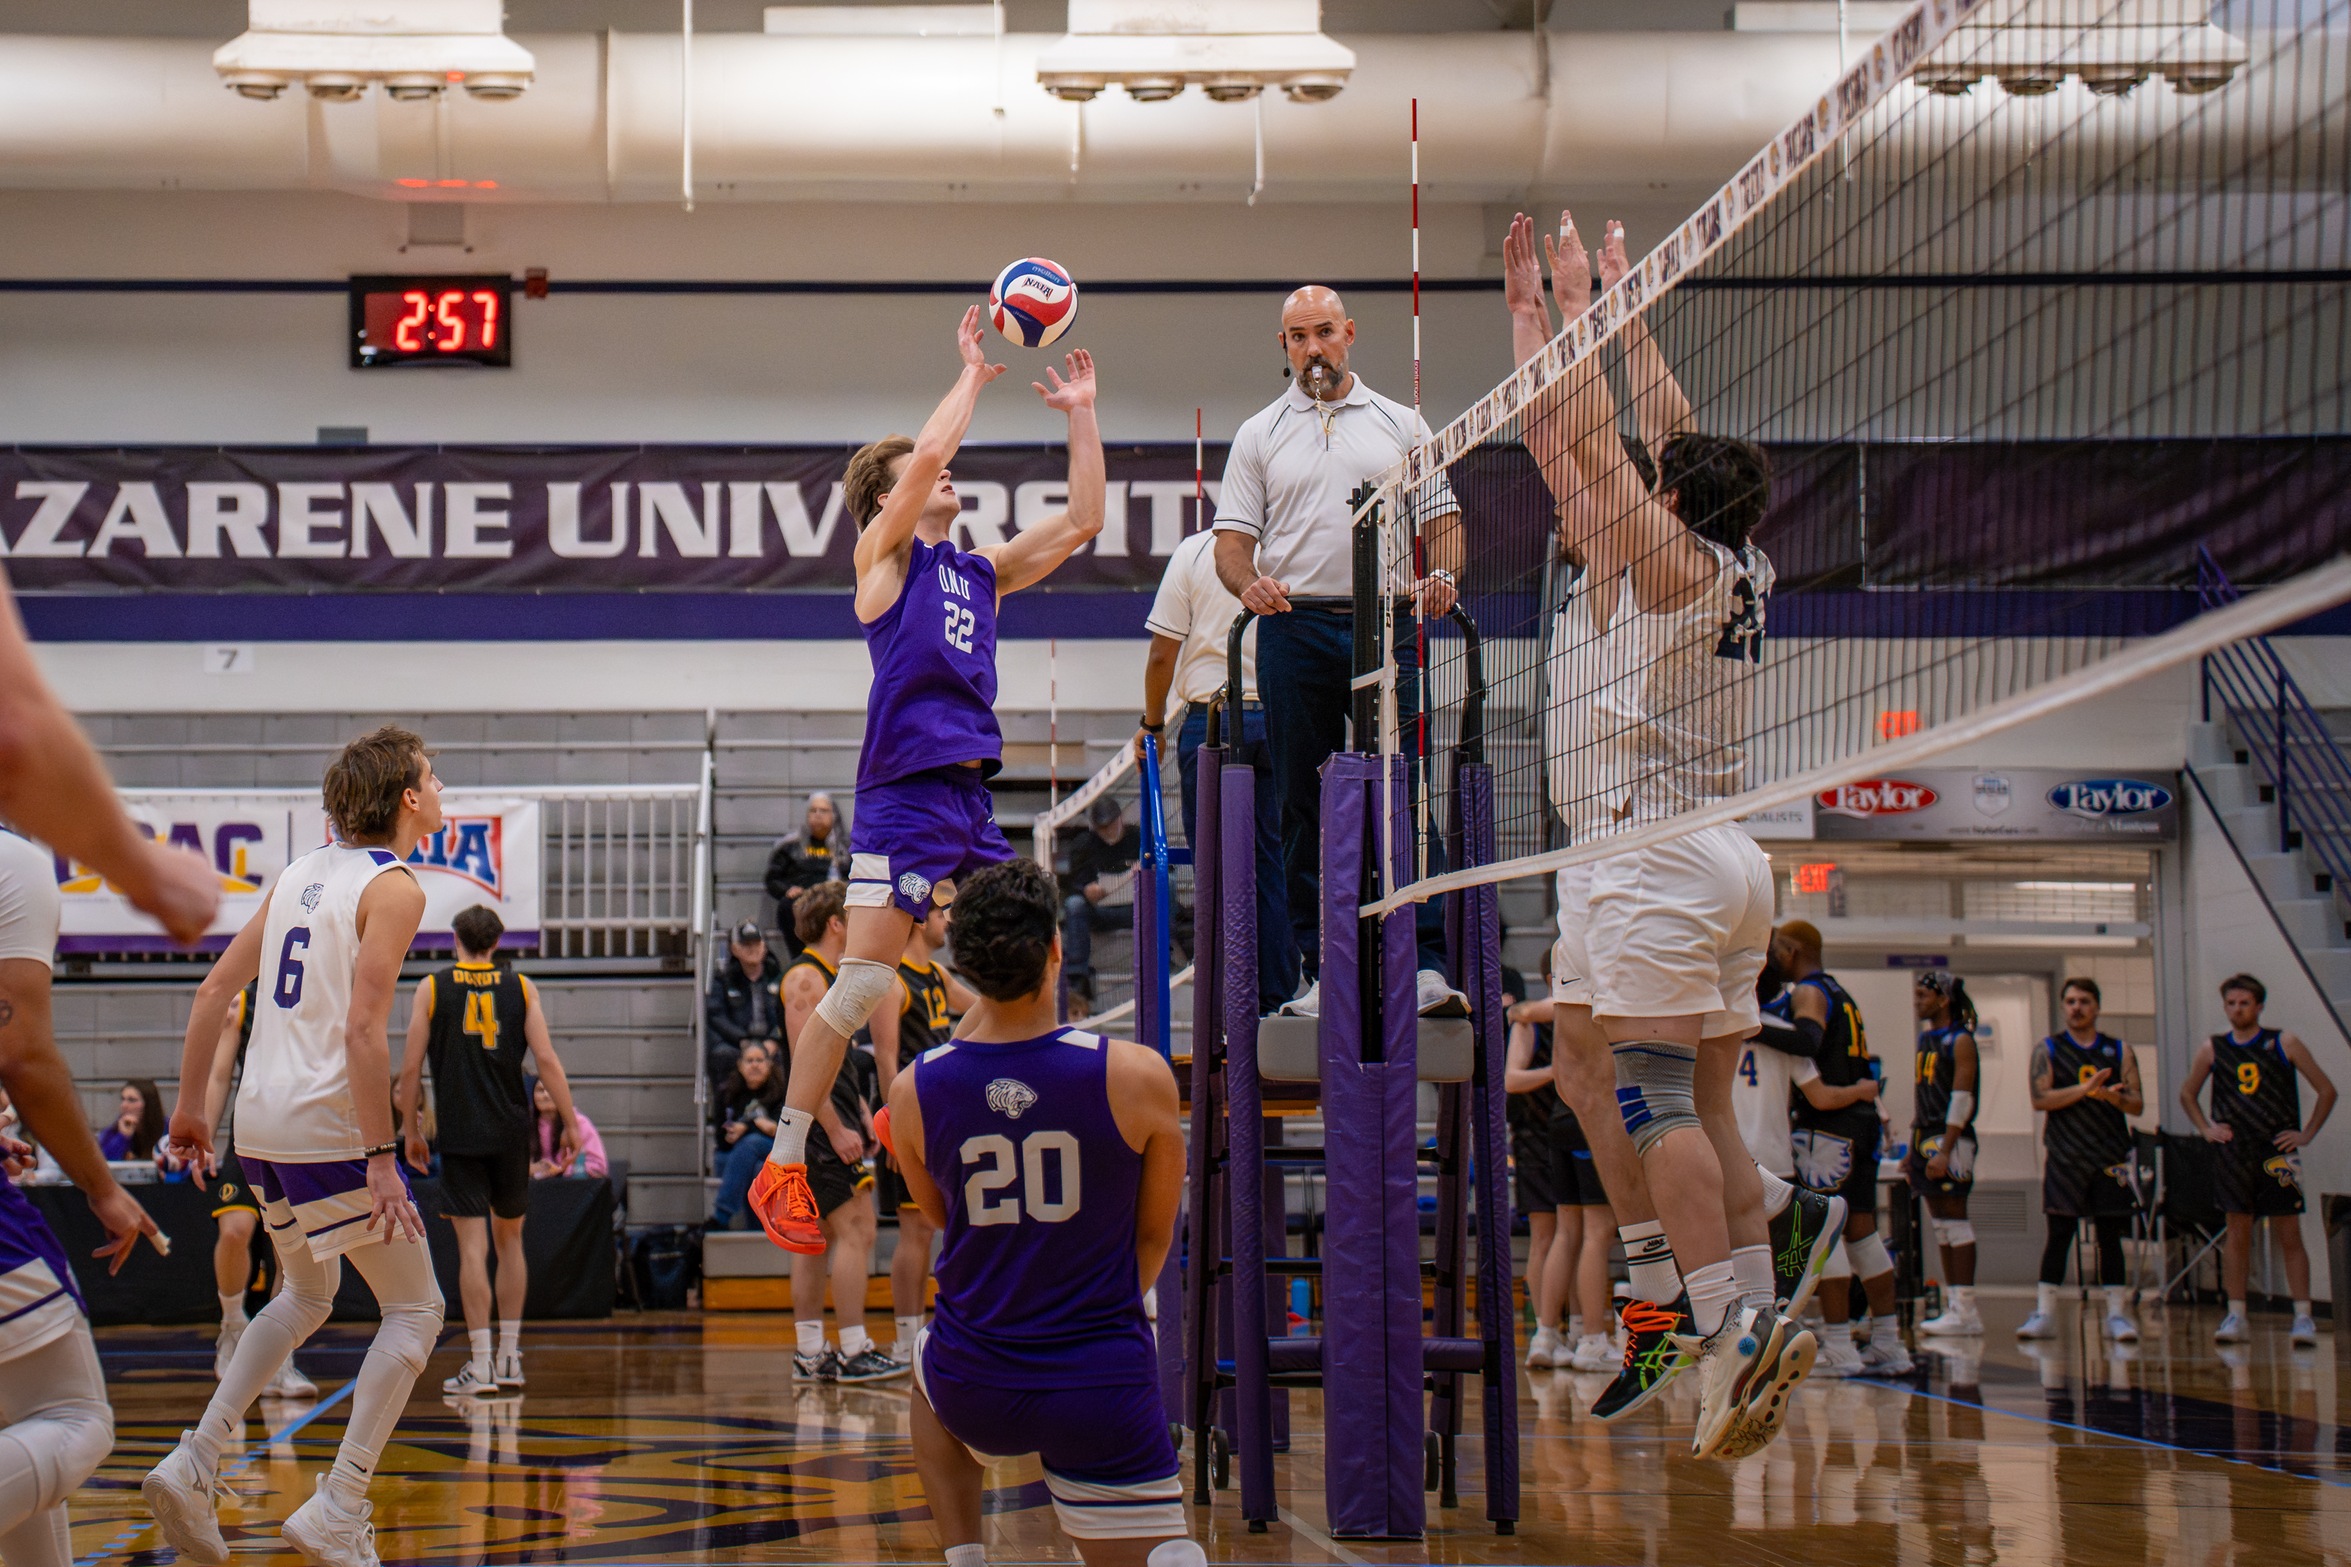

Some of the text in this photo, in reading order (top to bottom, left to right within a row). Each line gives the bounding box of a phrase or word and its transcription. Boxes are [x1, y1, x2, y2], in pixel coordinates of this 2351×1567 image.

[1022, 277, 1053, 300] NAIA
[396, 290, 498, 351] 2:57
[0, 481, 1219, 559] ZARENE UNIVRSIT
[938, 564, 970, 601] ONU
[943, 600, 975, 655] 22
[217, 649, 239, 670] 7
[1834, 781, 2158, 816] Taylor Taylor
[1800, 863, 1836, 893] EXIT
[273, 926, 312, 1010] 6
[462, 990, 500, 1050] 4
[921, 985, 950, 1030] 12
[1739, 1049, 1758, 1087] 4
[2237, 1062, 2261, 1095] 9
[959, 1130, 1081, 1227] 20
